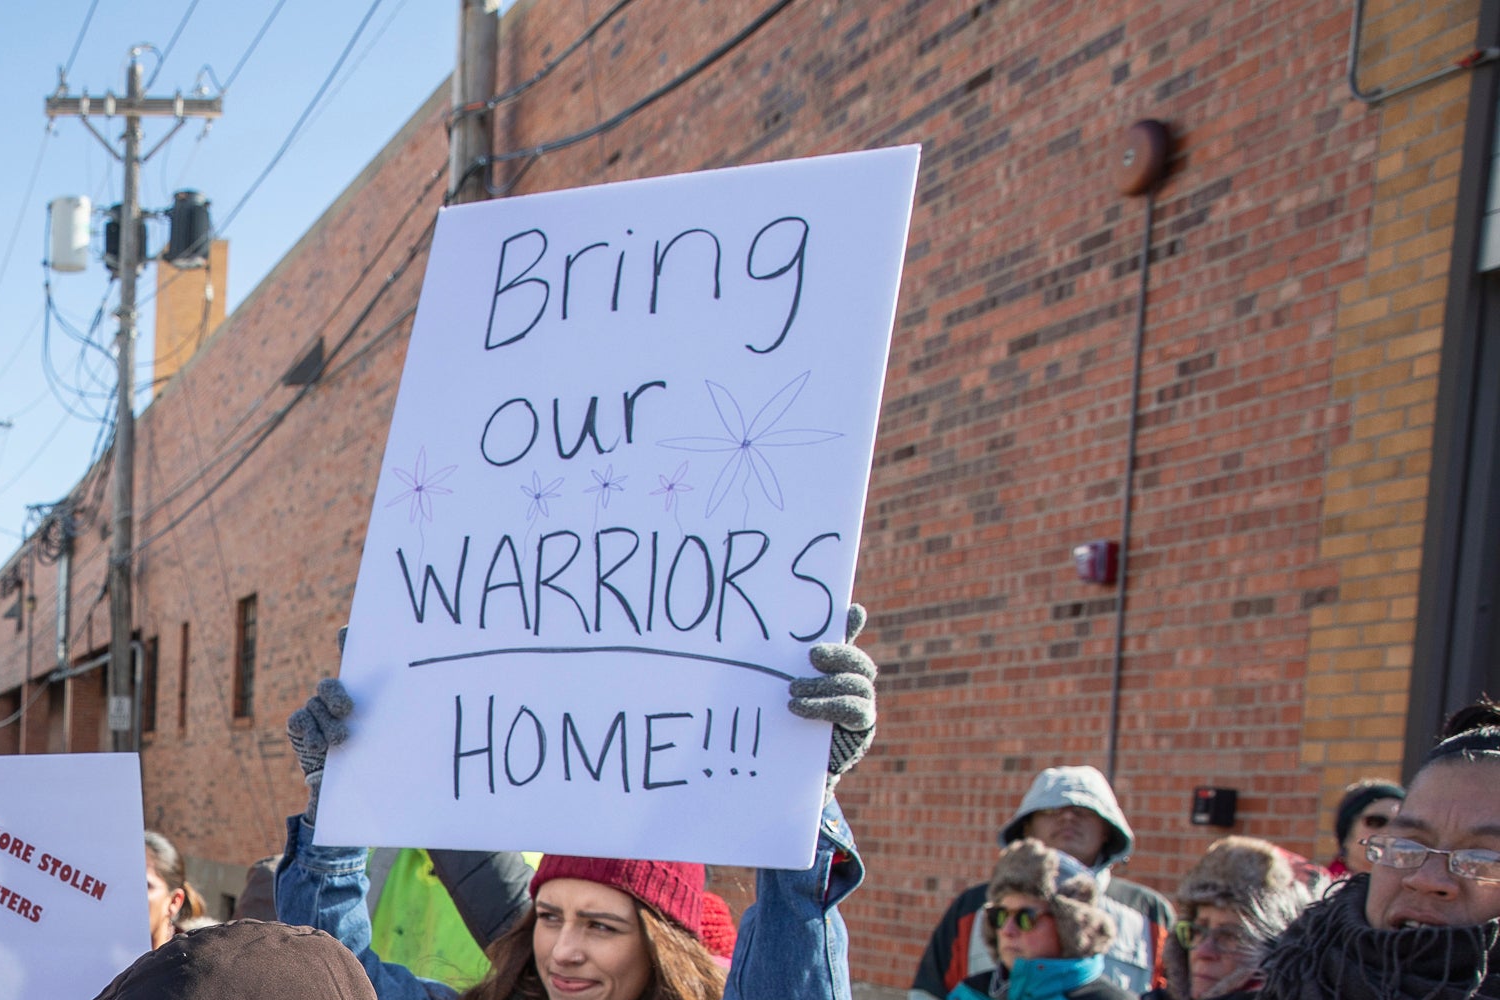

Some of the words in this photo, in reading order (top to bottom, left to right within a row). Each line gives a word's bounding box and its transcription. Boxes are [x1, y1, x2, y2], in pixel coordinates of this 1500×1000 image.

[484, 215, 810, 354] Bring
[480, 379, 667, 467] our
[397, 526, 841, 644] WARRIORS
[454, 694, 762, 800] HOME!!!
[37, 852, 107, 901] STOLEN
